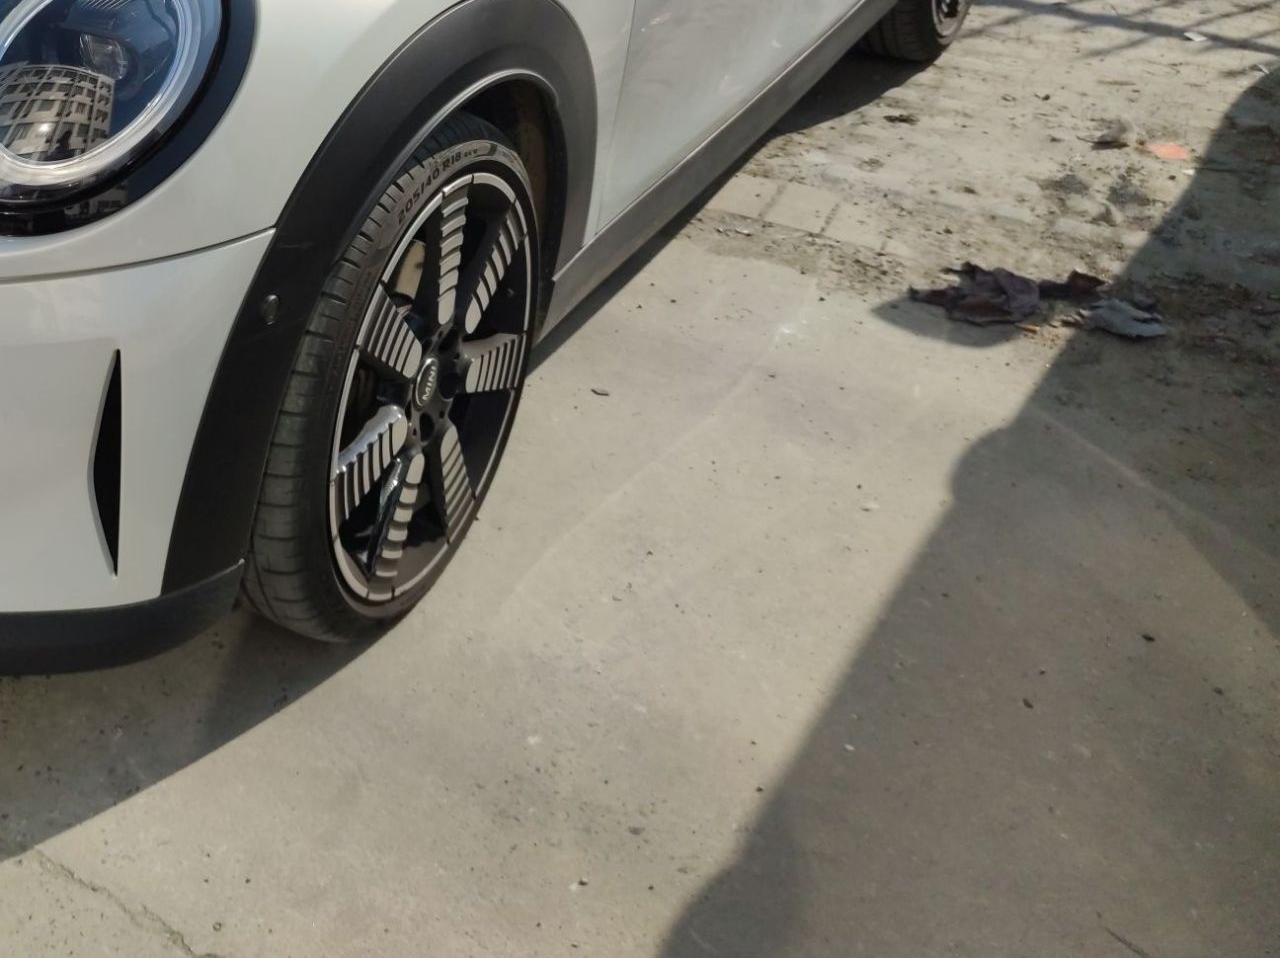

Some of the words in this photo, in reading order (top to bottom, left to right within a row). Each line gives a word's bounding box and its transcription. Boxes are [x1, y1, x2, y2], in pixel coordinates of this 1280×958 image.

[398, 168, 440, 225] 205/40
[442, 152, 462, 171] R18
[422, 366, 437, 400] MINI
